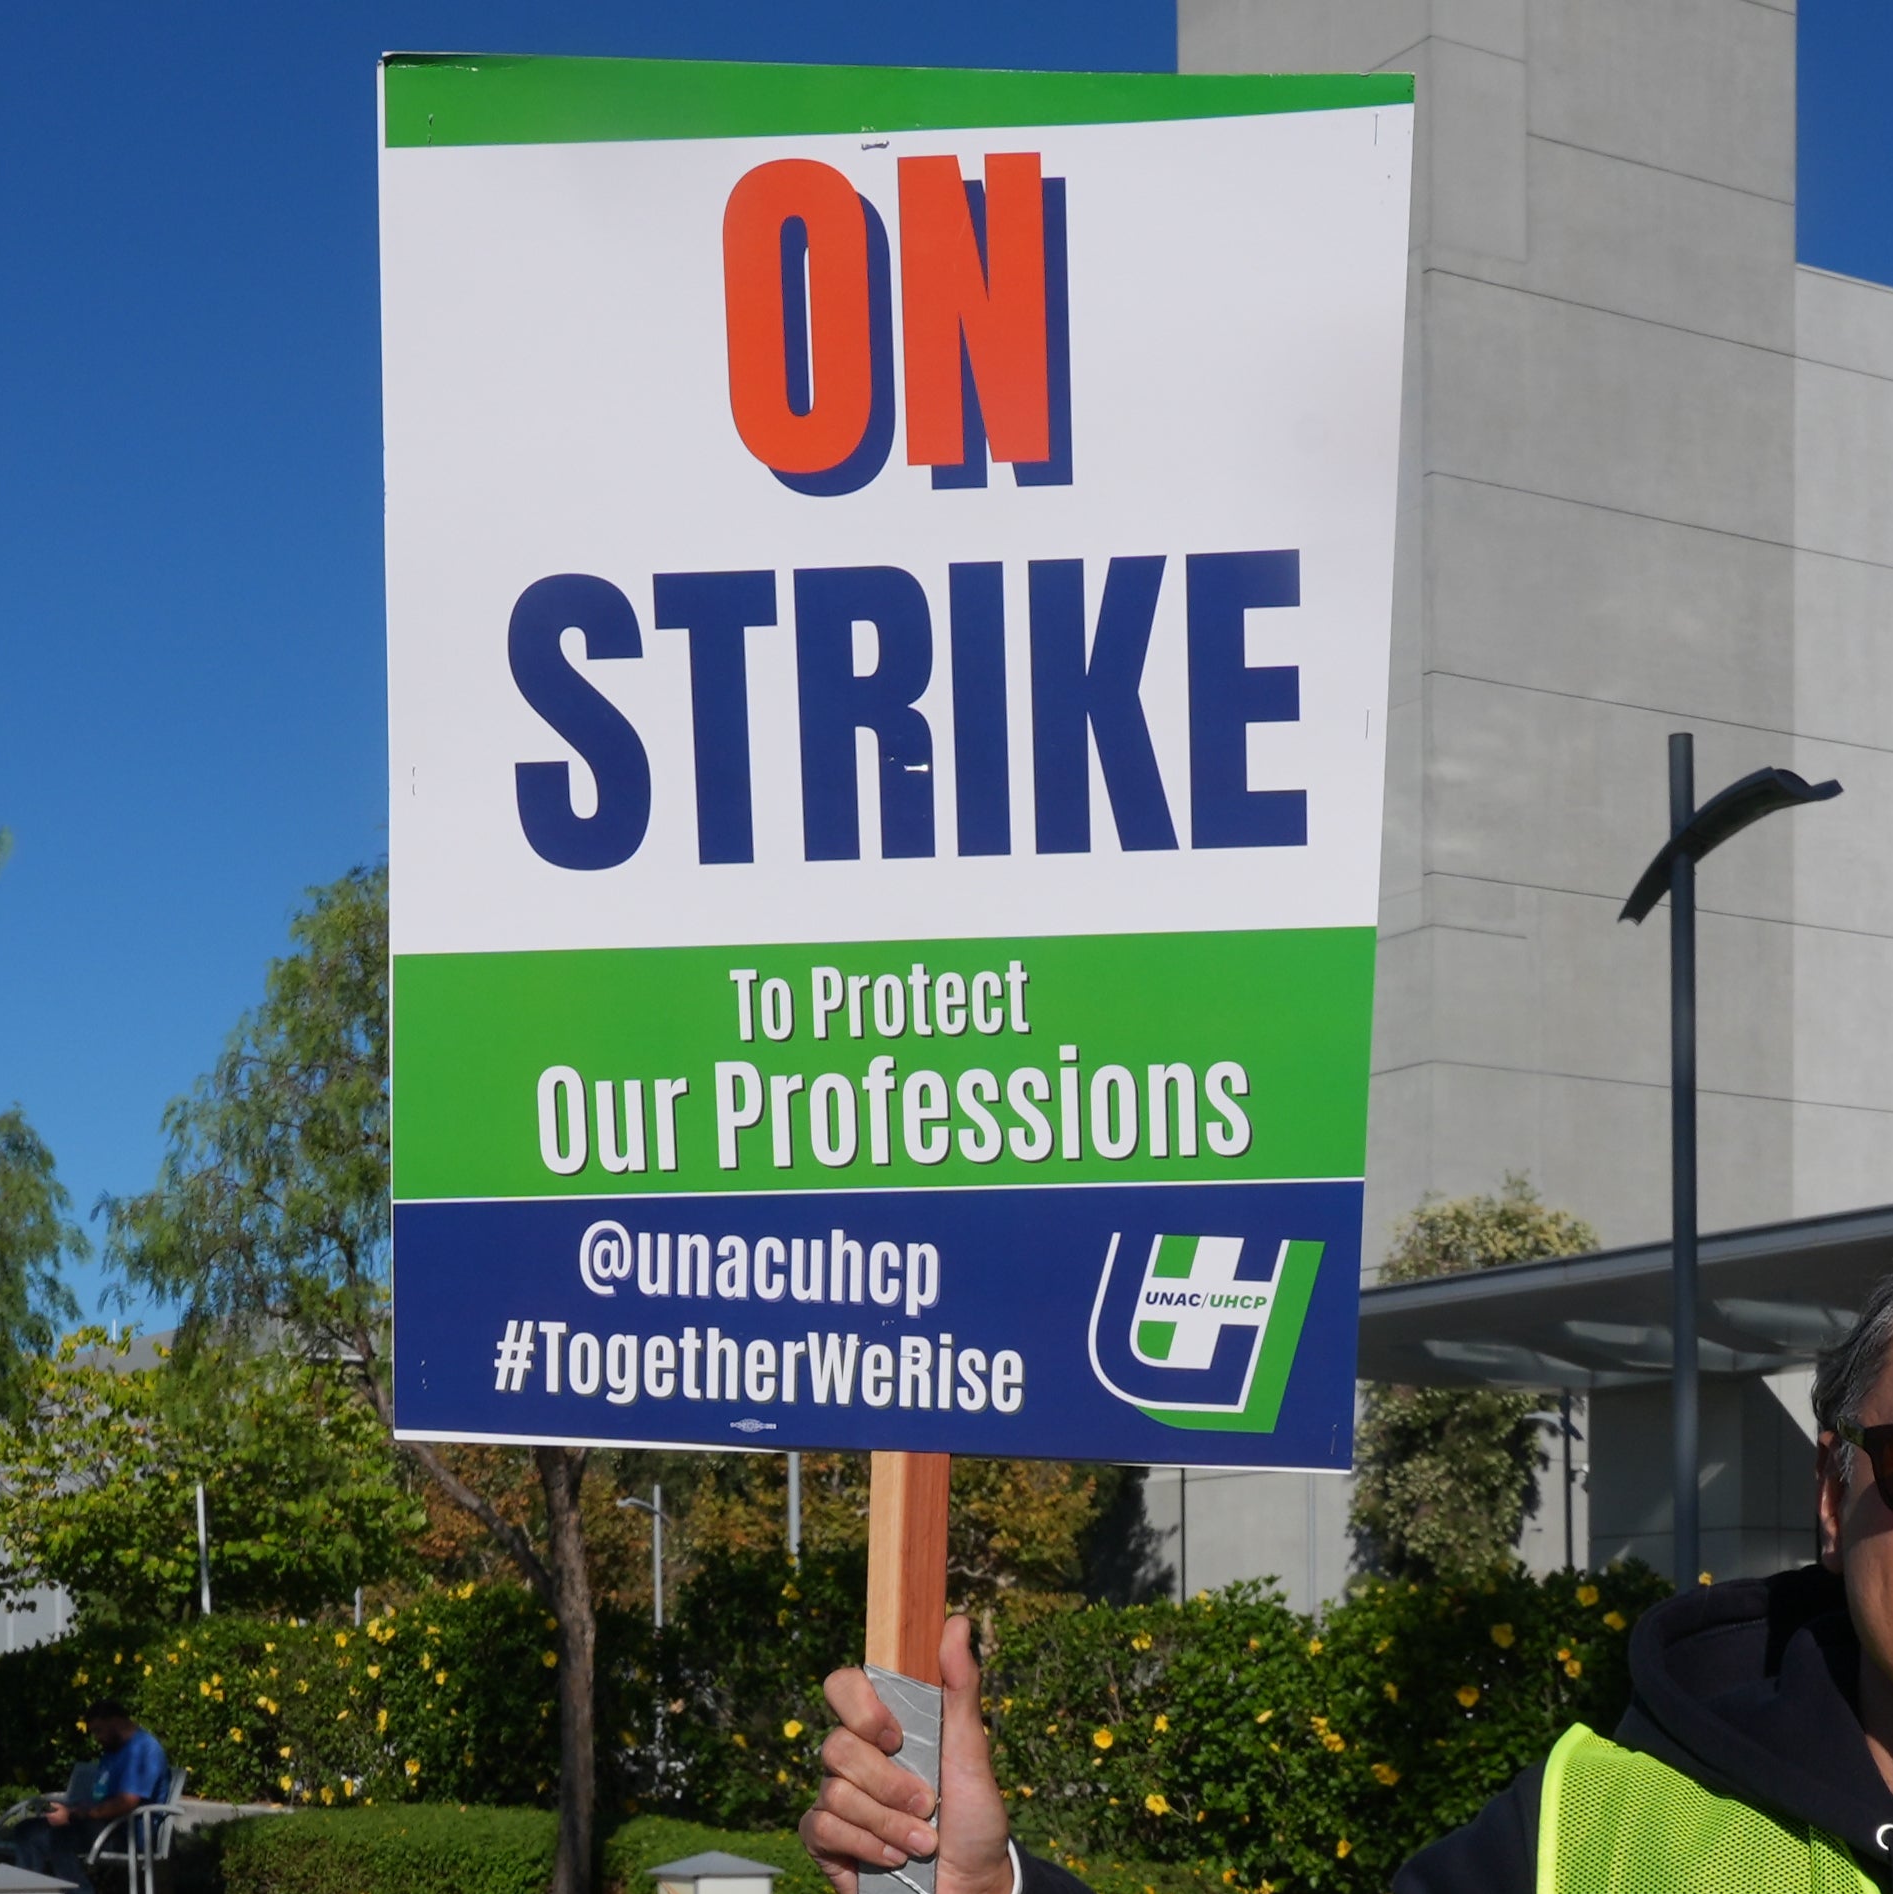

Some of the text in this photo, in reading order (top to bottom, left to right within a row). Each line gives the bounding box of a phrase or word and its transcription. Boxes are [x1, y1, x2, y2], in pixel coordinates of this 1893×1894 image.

[723, 152, 1072, 496] ON
[508, 549, 1307, 870] STRIKE
[729, 959, 1030, 1042] To Protect
[537, 1045, 1253, 1176] Our Professions
[579, 1219, 941, 1317] @unacuhcp
[1145, 1291, 1267, 1310] UNAC/UHCP
[494, 1318, 1025, 1414] #TogetherWeRise
